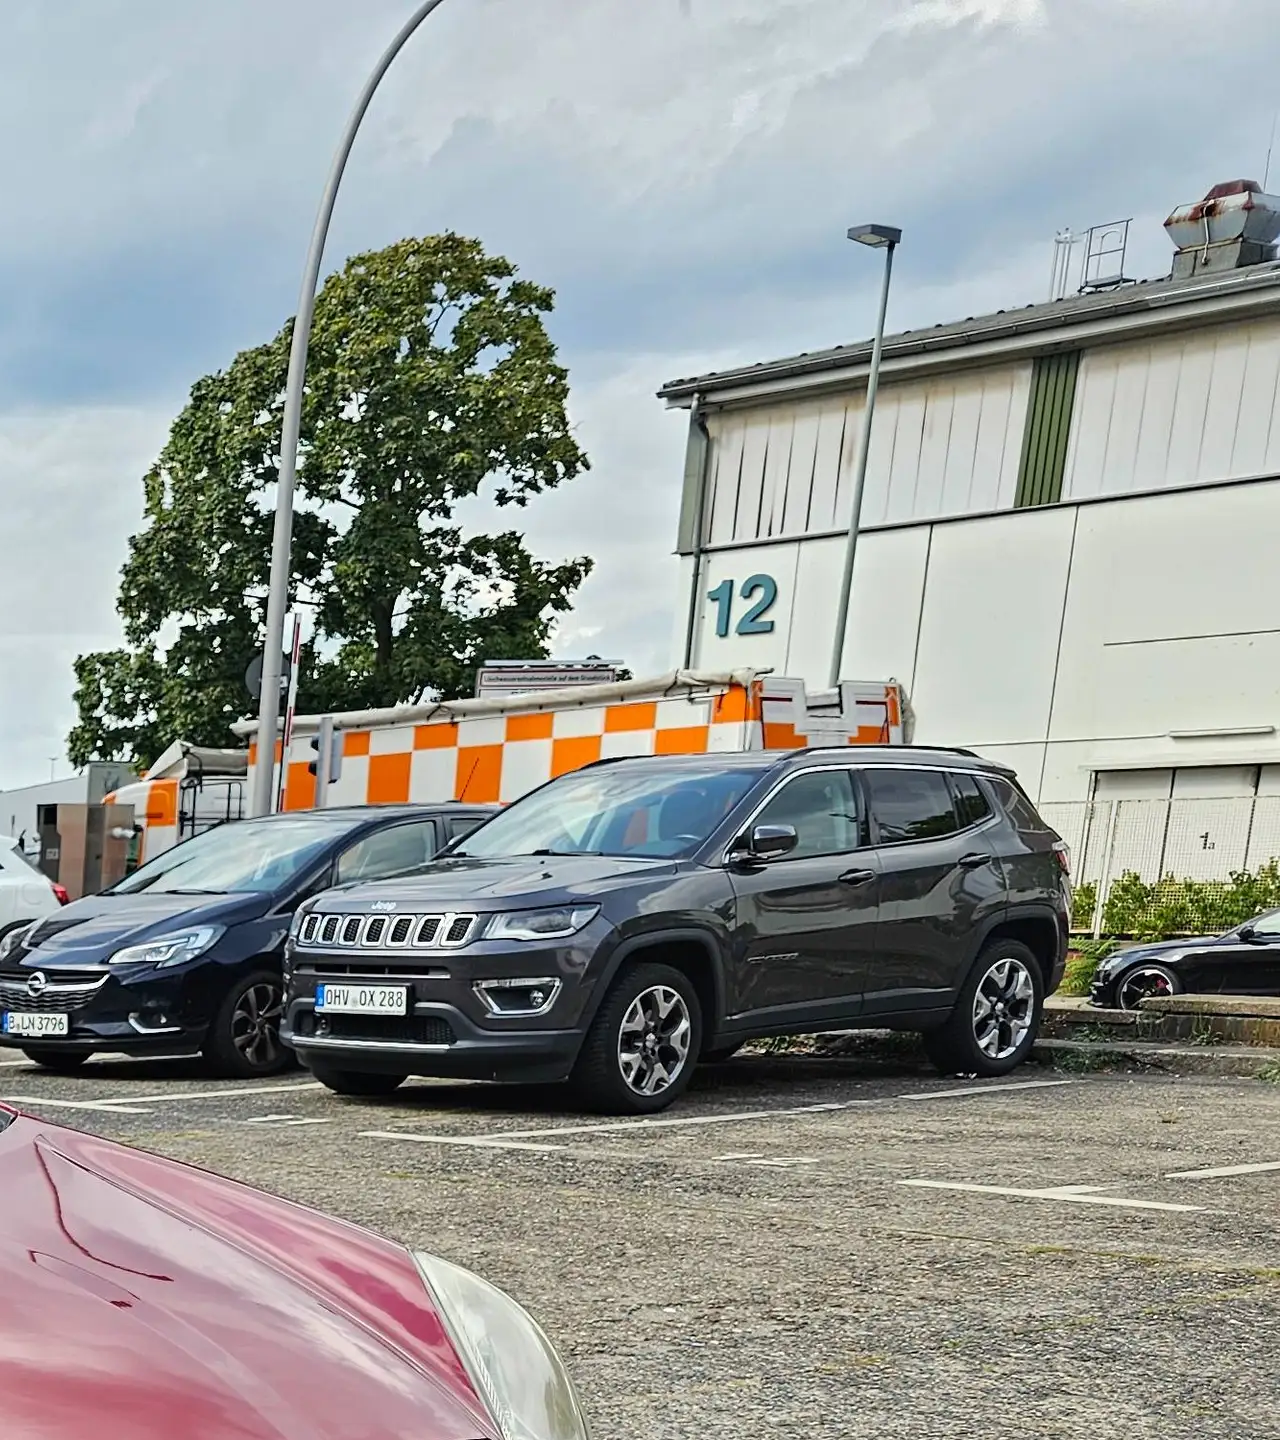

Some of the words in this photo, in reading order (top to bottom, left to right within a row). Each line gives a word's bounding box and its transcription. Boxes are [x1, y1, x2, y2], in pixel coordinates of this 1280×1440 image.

[706, 573, 778, 637] 12
[326, 989, 350, 1006] OHV
[359, 990, 375, 1007] OX
[379, 991, 404, 1008] 288
[8, 1015, 15, 1030] B
[21, 1016, 35, 1031] LN
[37, 1016, 65, 1031] 3796
